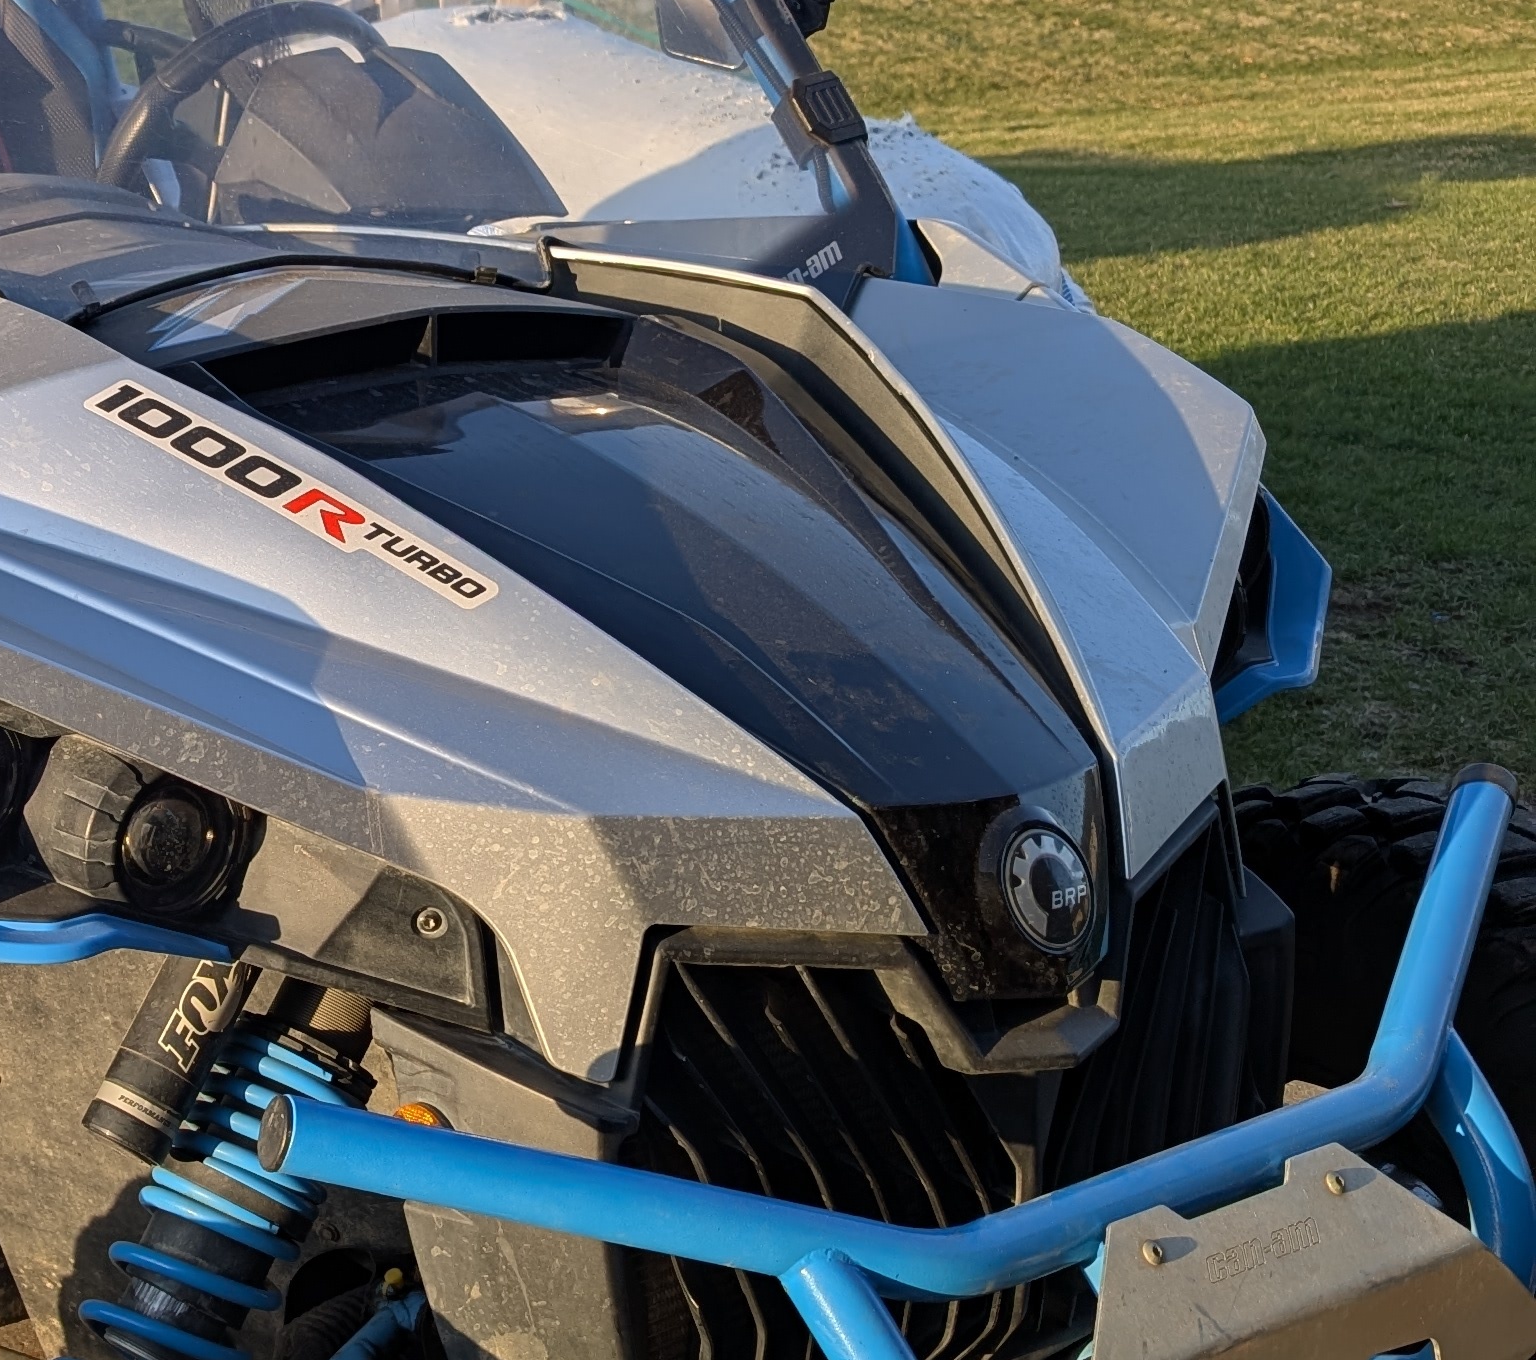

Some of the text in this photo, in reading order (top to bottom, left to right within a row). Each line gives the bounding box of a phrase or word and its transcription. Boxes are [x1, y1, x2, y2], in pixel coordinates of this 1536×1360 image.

[781, 240, 843, 284] n-am
[95, 384, 487, 599] 1000R TURBO
[1051, 884, 1087, 910] BRP
[158, 960, 246, 1073] FOX
[1205, 1216, 1321, 1284] can-am
